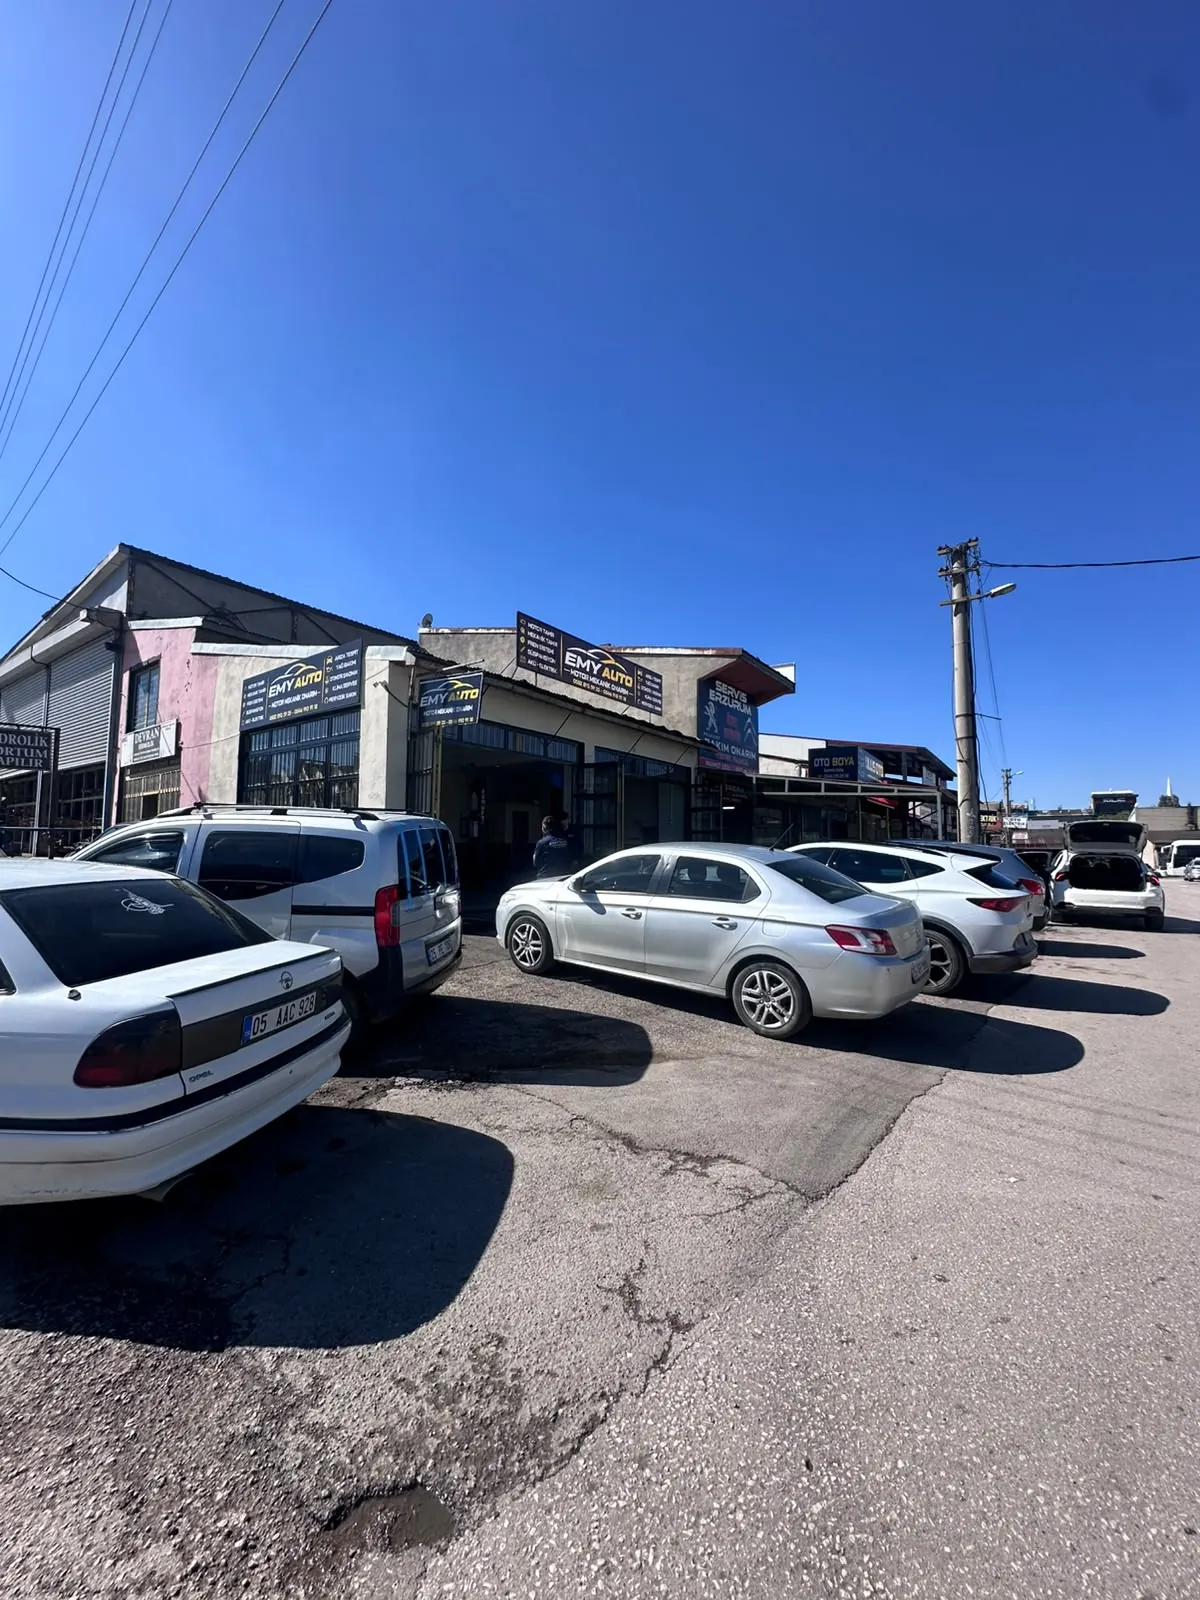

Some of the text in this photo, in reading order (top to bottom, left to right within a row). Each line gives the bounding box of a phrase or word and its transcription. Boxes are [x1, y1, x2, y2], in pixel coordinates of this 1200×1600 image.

[564, 651, 602, 675] EMY
[601, 666, 633, 688] AUTO
[570, 668, 589, 681] MOTOR
[268, 671, 322, 698] EMY AUTO
[715, 680, 747, 702] SERVİS
[420, 688, 480, 707] EMY AUTO
[709, 688, 752, 716] ERZURUM
[0, 733, 48, 747] DROLİK
[134, 727, 160, 745] DEVRAN
[730, 745, 757, 761] ONARIM
[814, 758, 830, 767] OTO
[832, 756, 854, 767] BOYA
[252, 994, 315, 1036] 05 AAC 928
[189, 1070, 214, 1082] OPEL
